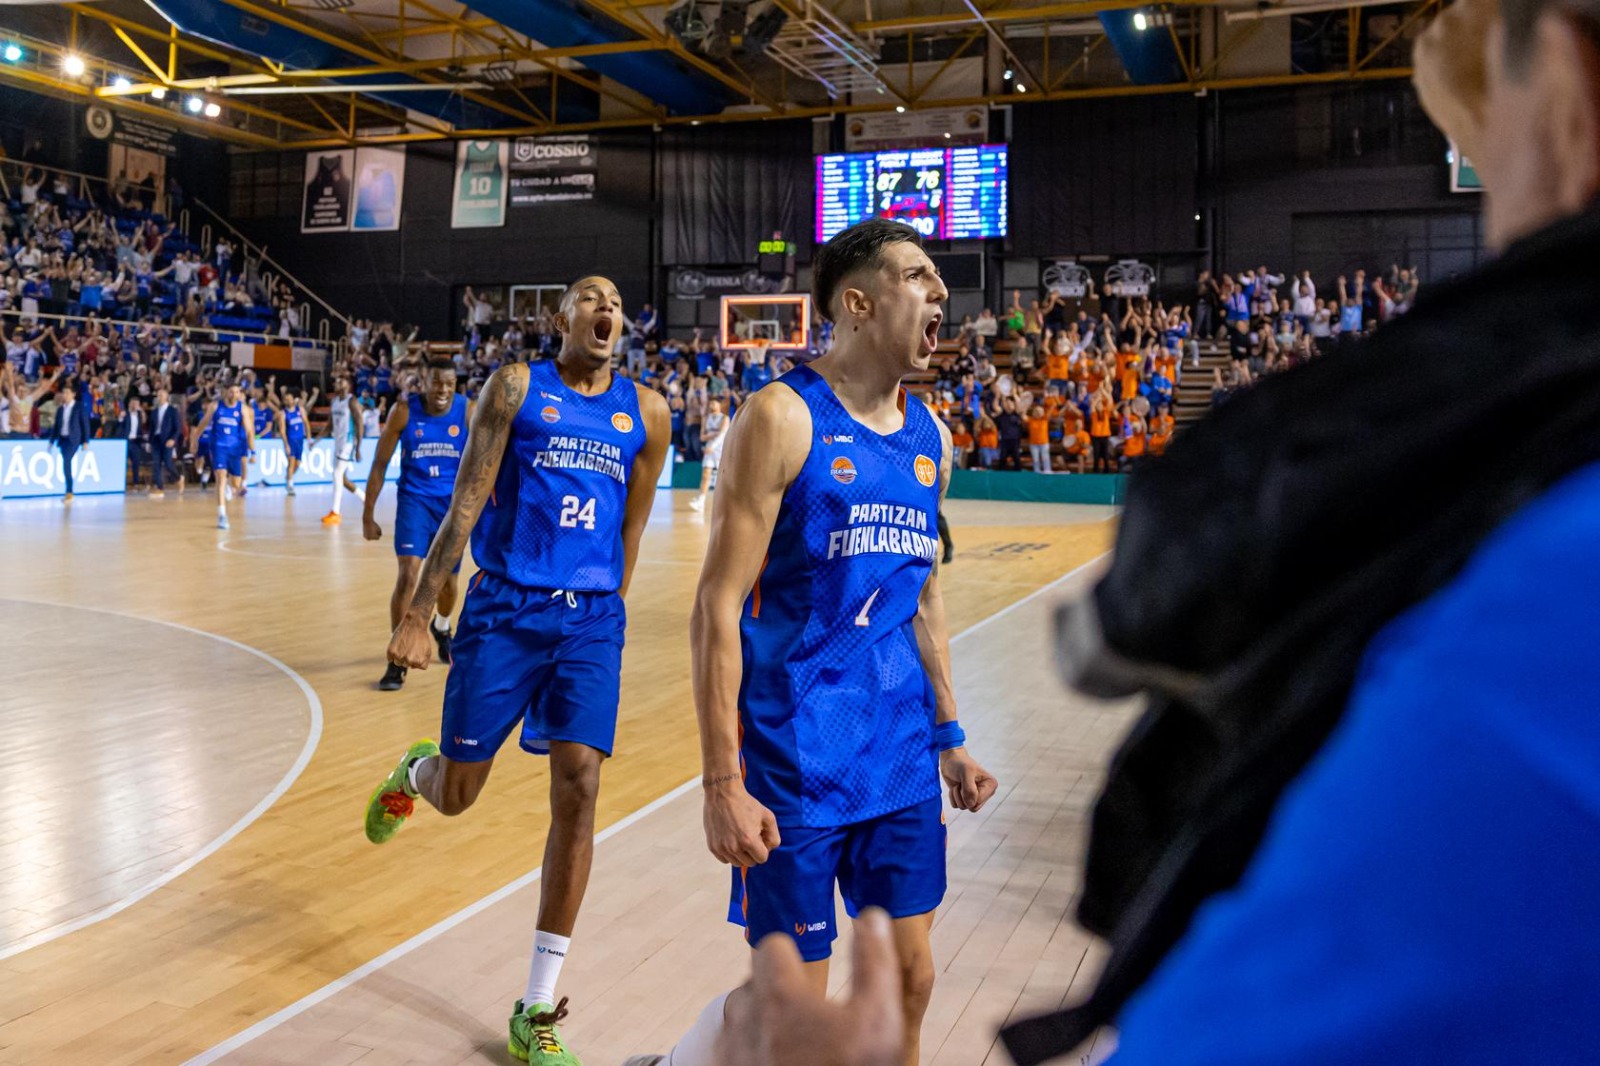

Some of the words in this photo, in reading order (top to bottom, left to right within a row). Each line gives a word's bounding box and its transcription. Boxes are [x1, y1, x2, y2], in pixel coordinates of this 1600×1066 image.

[469, 176, 492, 196] 10
[876, 172, 902, 191] 87
[916, 170, 940, 189] 76
[547, 436, 621, 461] PARTIZAN
[0, 445, 101, 490] ÁQUA
[532, 449, 626, 485] FUENLABRADA
[560, 495, 597, 530] 24
[848, 503, 928, 532] PARTIZAN
[807, 921, 827, 932] WIBO
